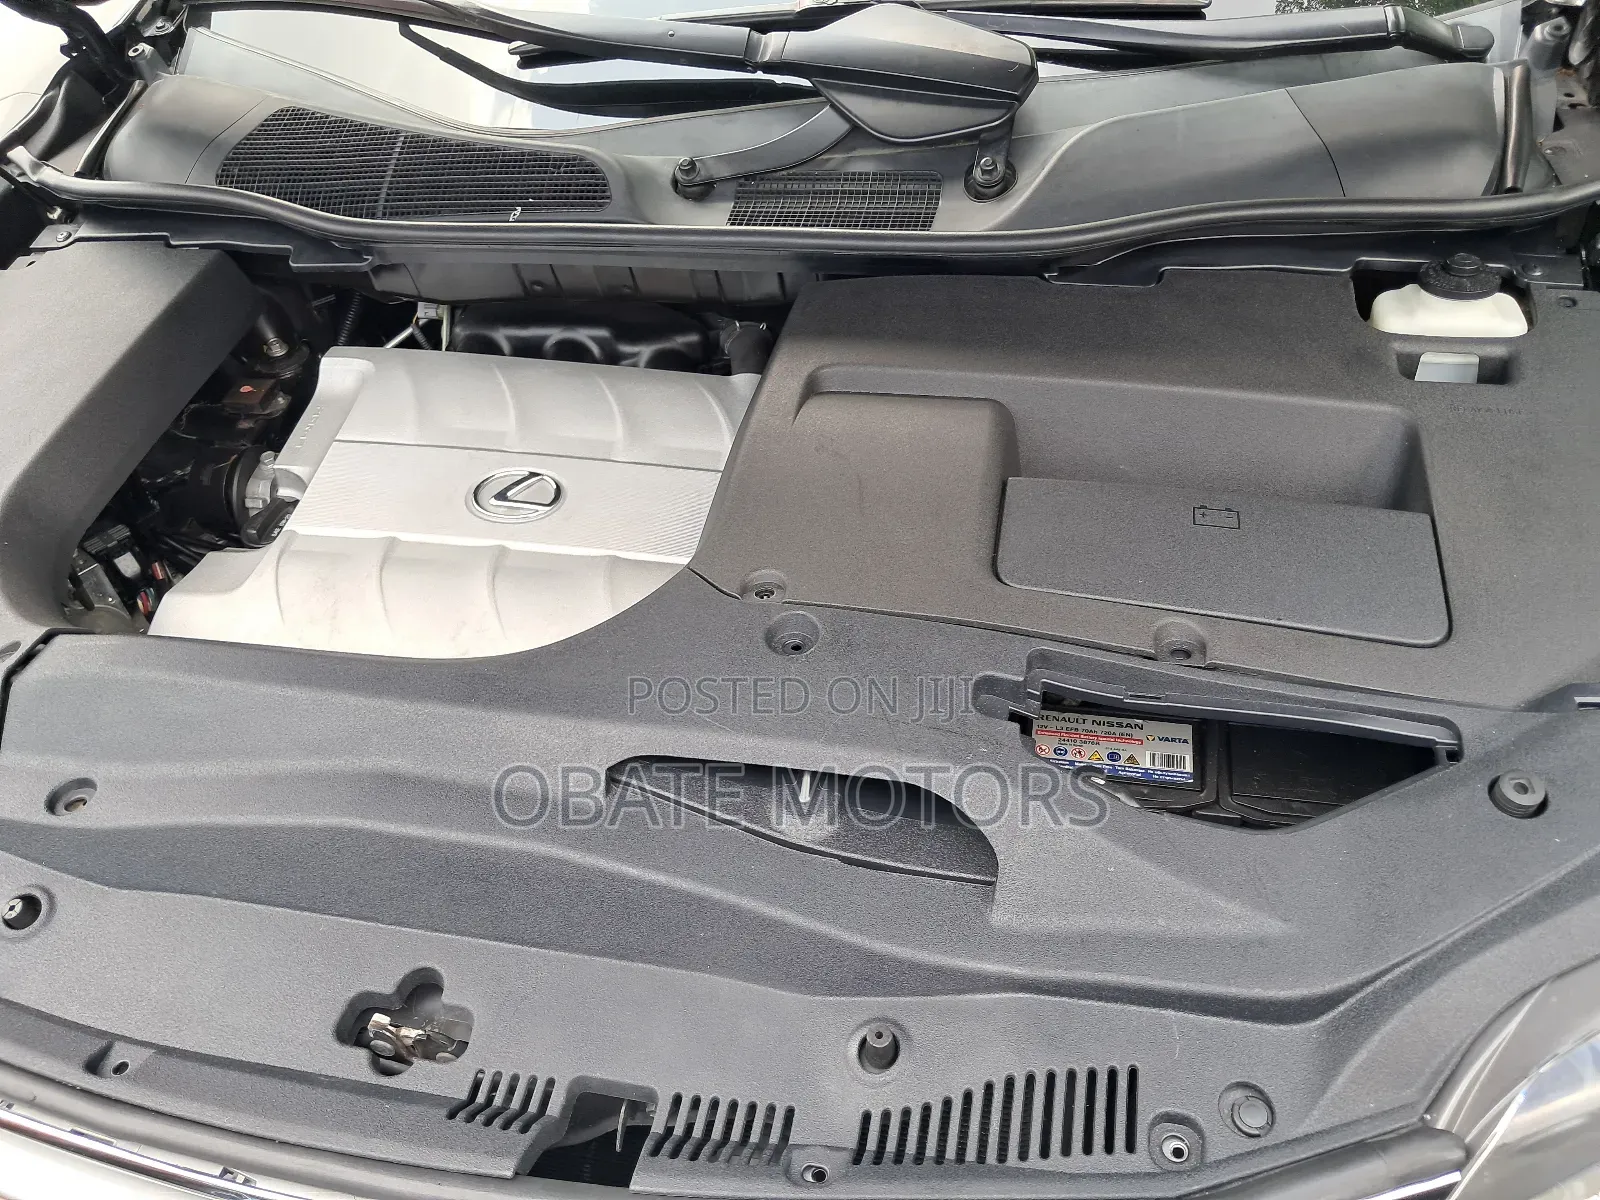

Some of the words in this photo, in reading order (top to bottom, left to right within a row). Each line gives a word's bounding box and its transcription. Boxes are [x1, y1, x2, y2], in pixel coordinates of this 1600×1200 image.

[1037, 714, 1088, 725] RENAULT
[1092, 719, 1144, 731] NISSAN
[1157, 735, 1190, 745] VARTA
